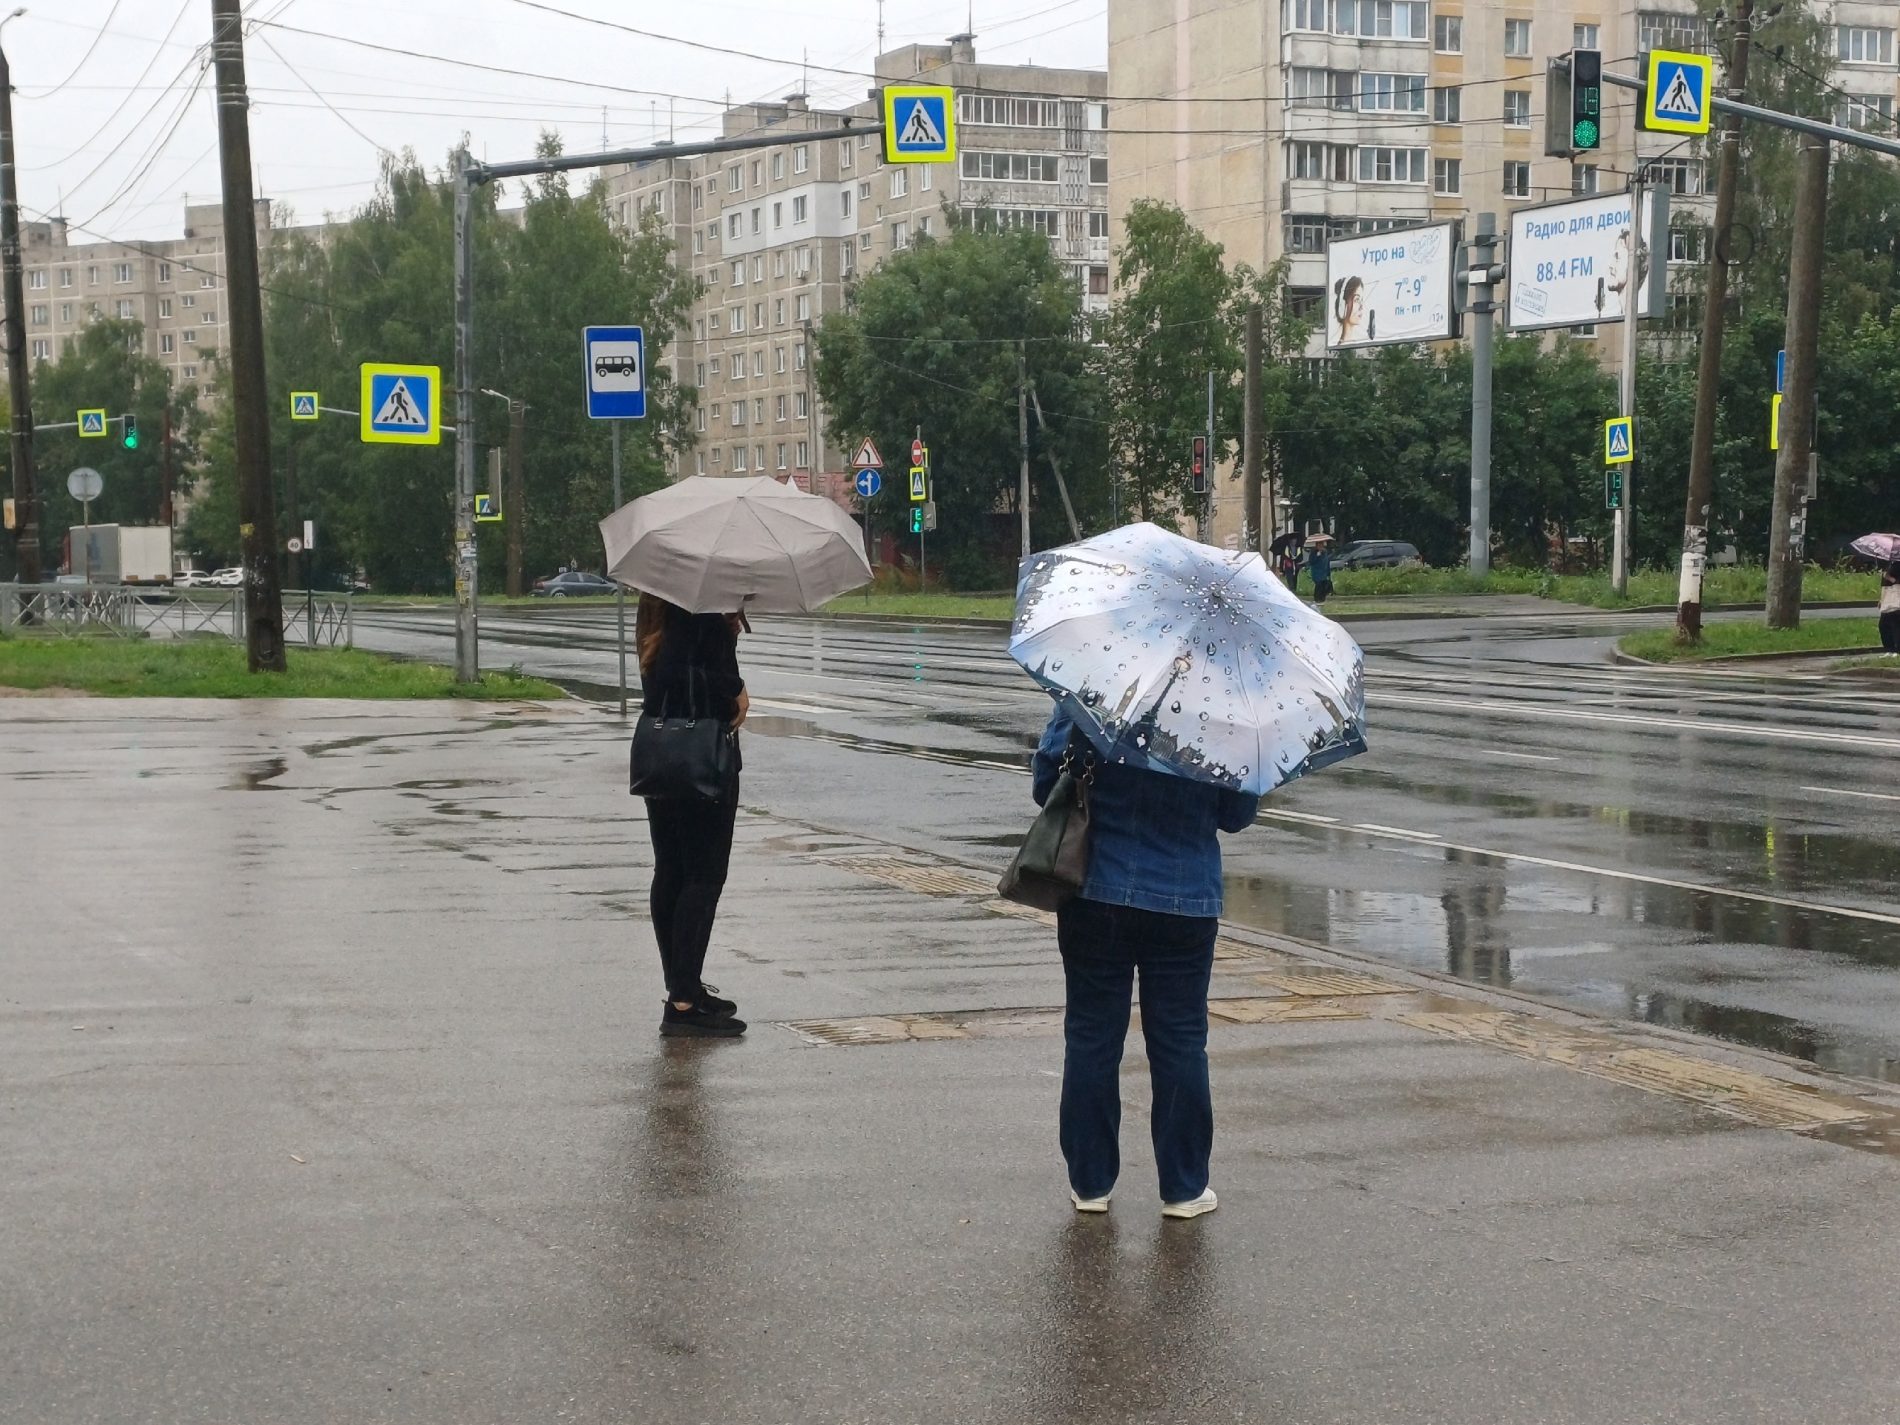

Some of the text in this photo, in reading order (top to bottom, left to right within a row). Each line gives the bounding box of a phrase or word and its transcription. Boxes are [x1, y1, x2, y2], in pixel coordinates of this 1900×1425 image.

[1525, 210, 1631, 240] Радио для двои
[1361, 247, 1388, 266] Утро
[1391, 246, 1405, 260] на
[1536, 256, 1593, 282] 88.4 FM
